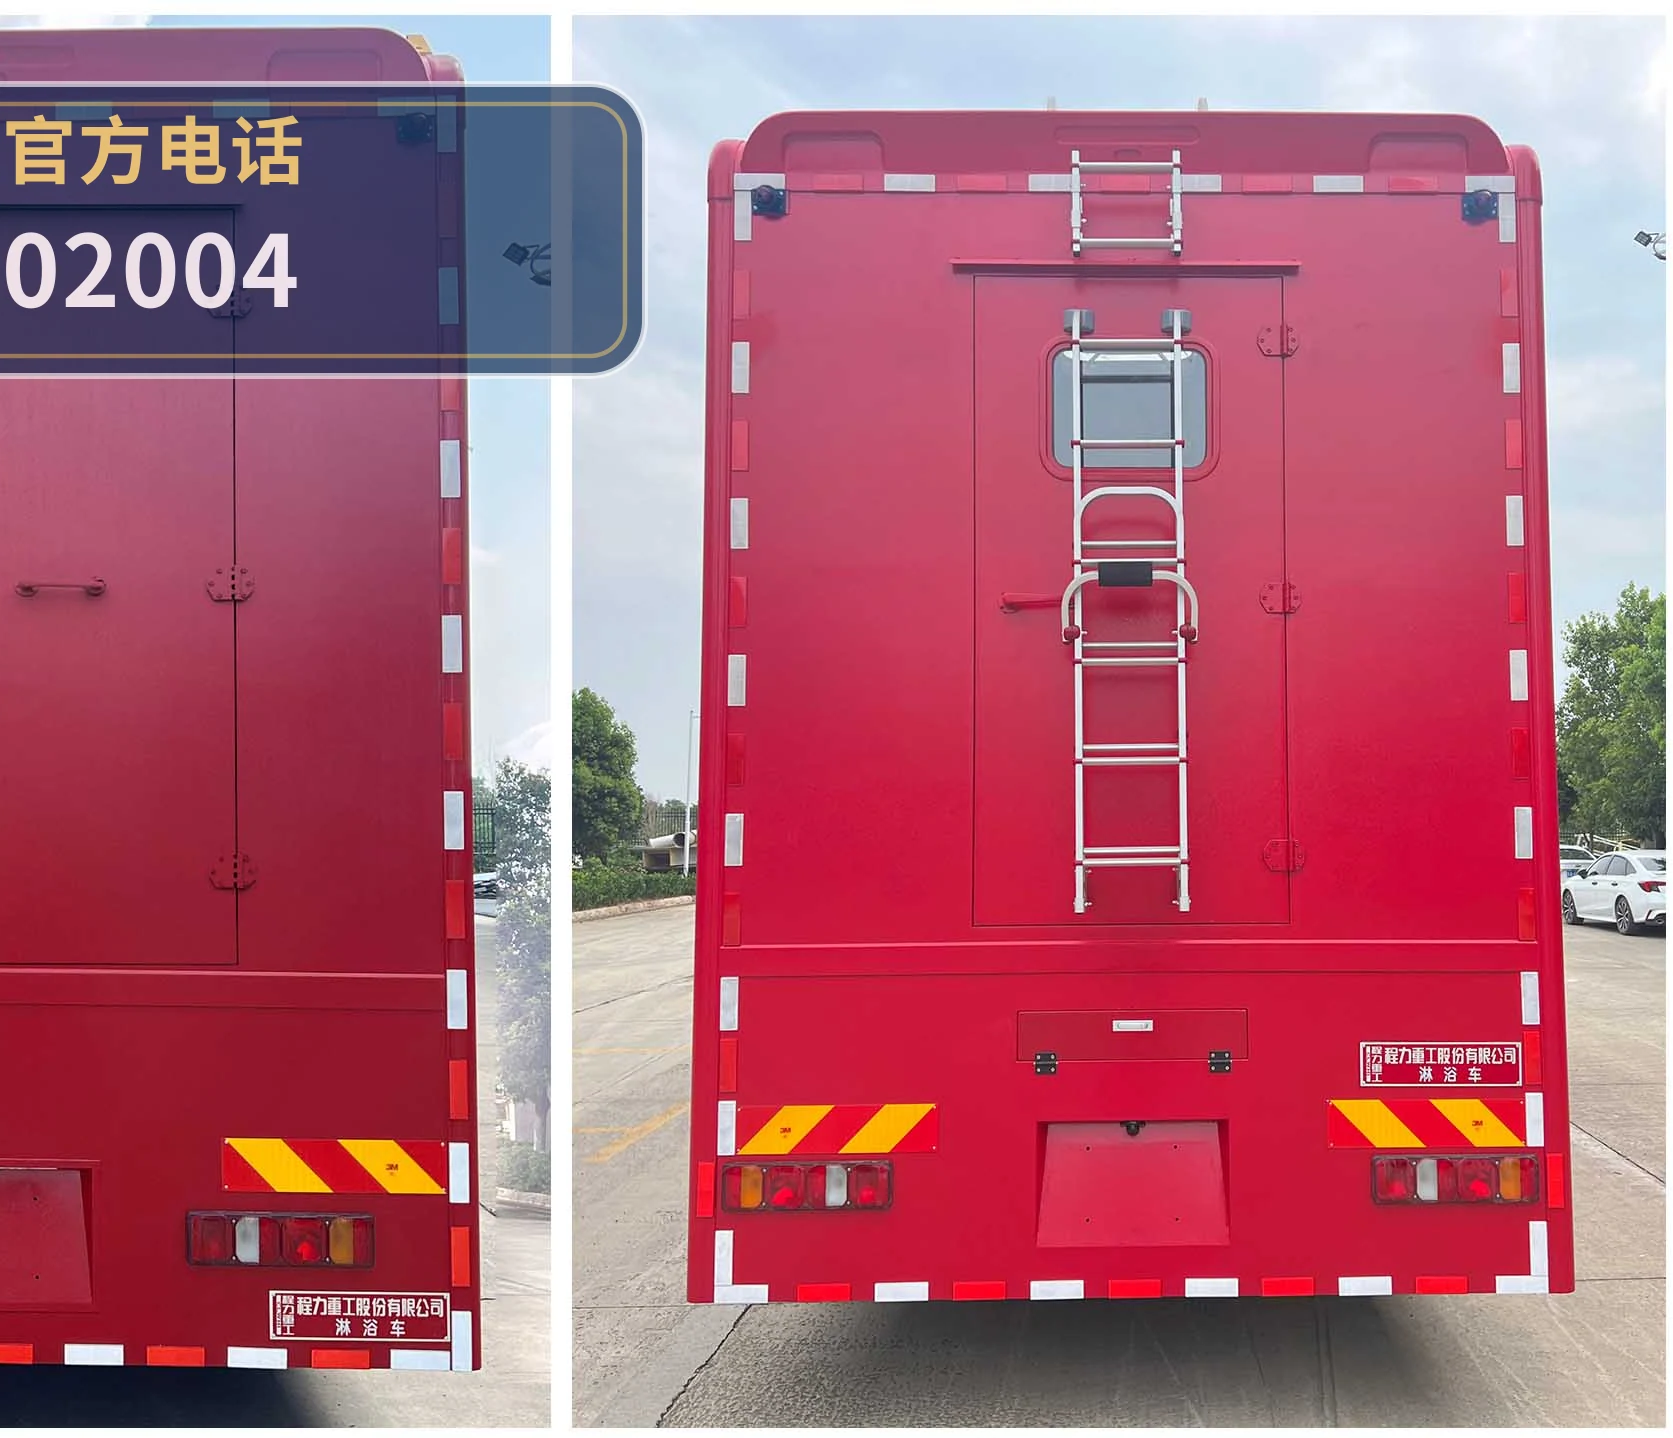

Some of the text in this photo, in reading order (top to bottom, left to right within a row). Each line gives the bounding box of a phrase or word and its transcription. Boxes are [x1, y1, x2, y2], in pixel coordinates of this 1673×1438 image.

[1384, 1046, 1517, 1065] 程力重工股份有限公司
[296, 1296, 444, 1318] 程力重工股份有限公司
